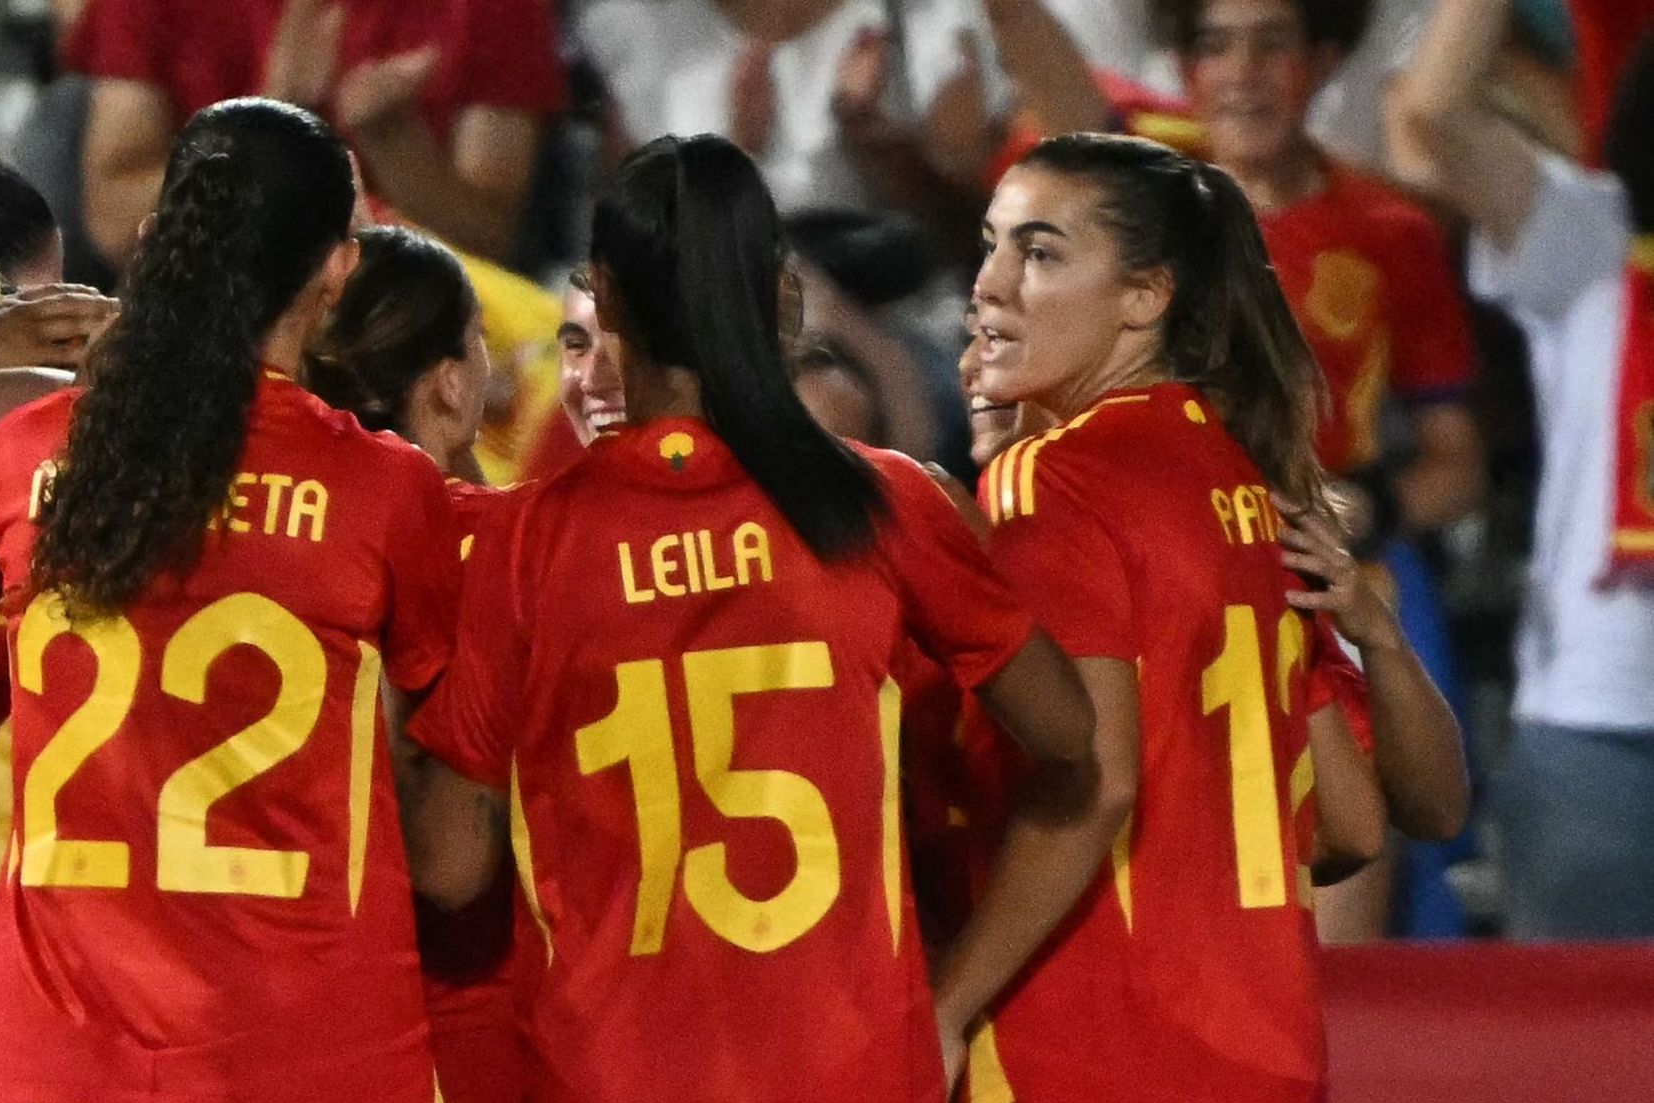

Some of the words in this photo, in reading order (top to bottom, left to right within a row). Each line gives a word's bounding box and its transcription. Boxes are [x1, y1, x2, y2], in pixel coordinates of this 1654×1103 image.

[618, 521, 773, 603] LEILA
[1210, 485, 1278, 545] PAT
[16, 590, 328, 899] 22
[575, 640, 842, 957] 15
